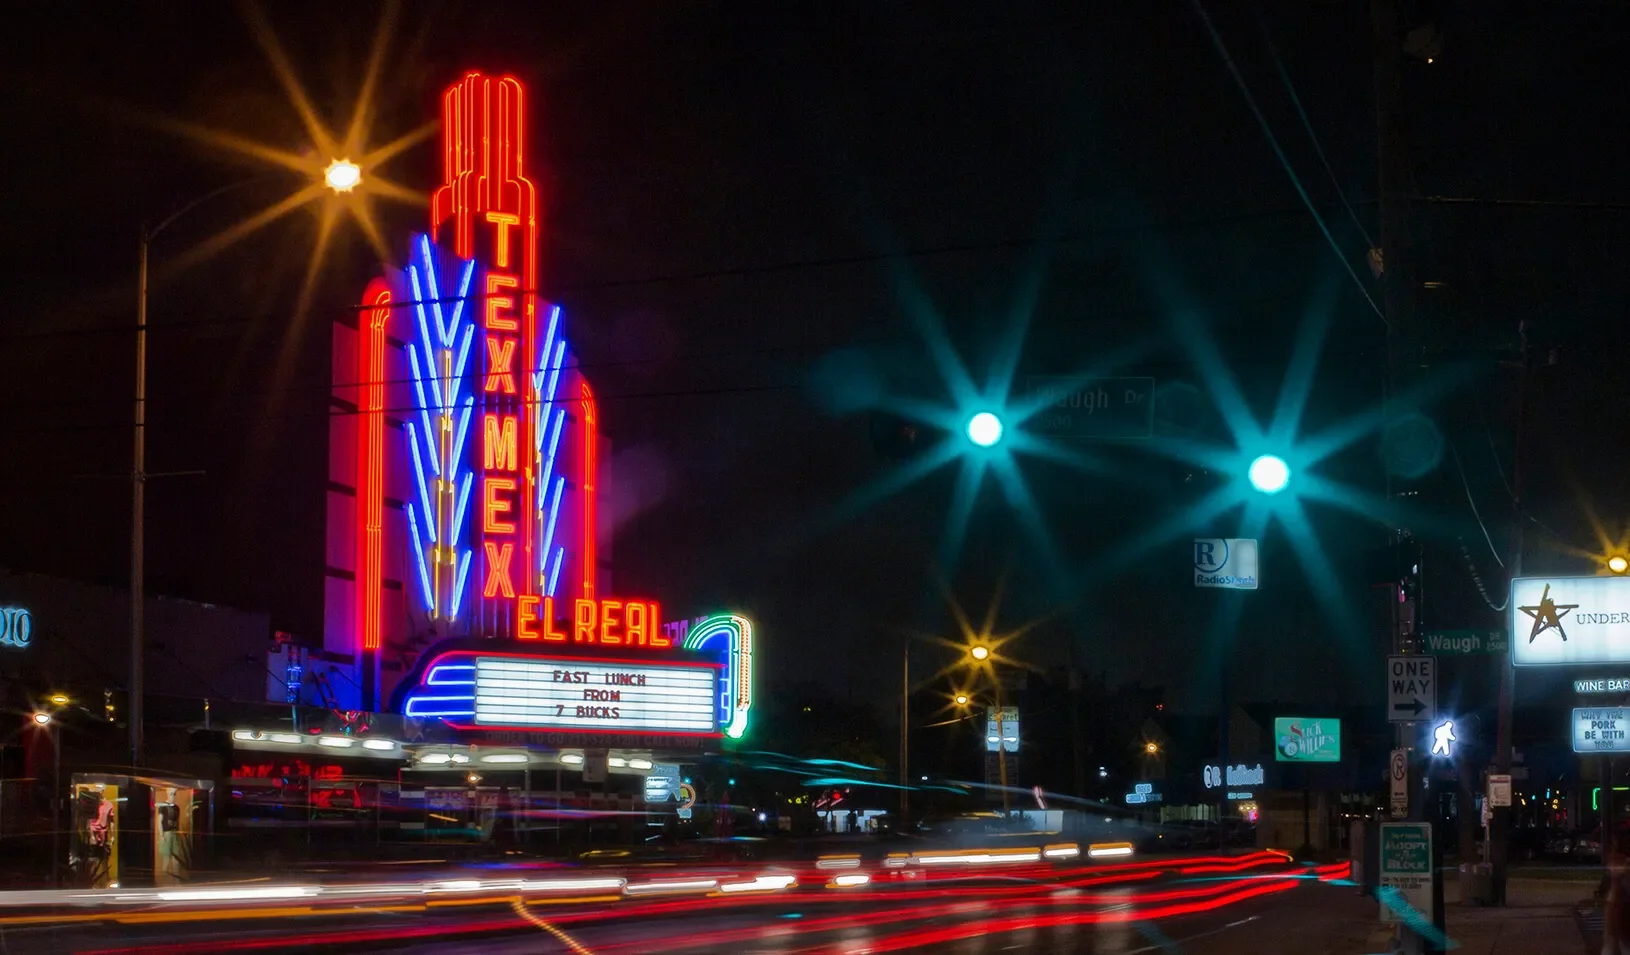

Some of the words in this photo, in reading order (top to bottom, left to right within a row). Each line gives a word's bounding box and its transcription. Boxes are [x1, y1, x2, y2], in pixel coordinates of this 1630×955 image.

[485, 211, 521, 394] TEX
[1035, 385, 1109, 416] Waugh
[1124, 388, 1145, 405] Dr
[483, 415, 517, 598] MEX
[1195, 542, 1216, 566] R
[517, 595, 567, 641] EL
[574, 598, 670, 648] REAL
[1428, 634, 1480, 652] Waugh
[1392, 661, 1430, 677] ONE
[553, 670, 590, 685] FAST
[605, 672, 647, 687] LUNCH
[1575, 680, 1605, 692] WINE
[1608, 680, 1630, 691] BAR
[583, 688, 621, 702] FROM
[1392, 680, 1430, 695] WAY
[556, 704, 565, 718] 7
[576, 705, 620, 719] BUCKS
[1591, 720, 1616, 730] PORK
[1584, 730, 1597, 740] BE
[1601, 730, 1625, 740] WITH
[1594, 740, 1614, 749] YOU
